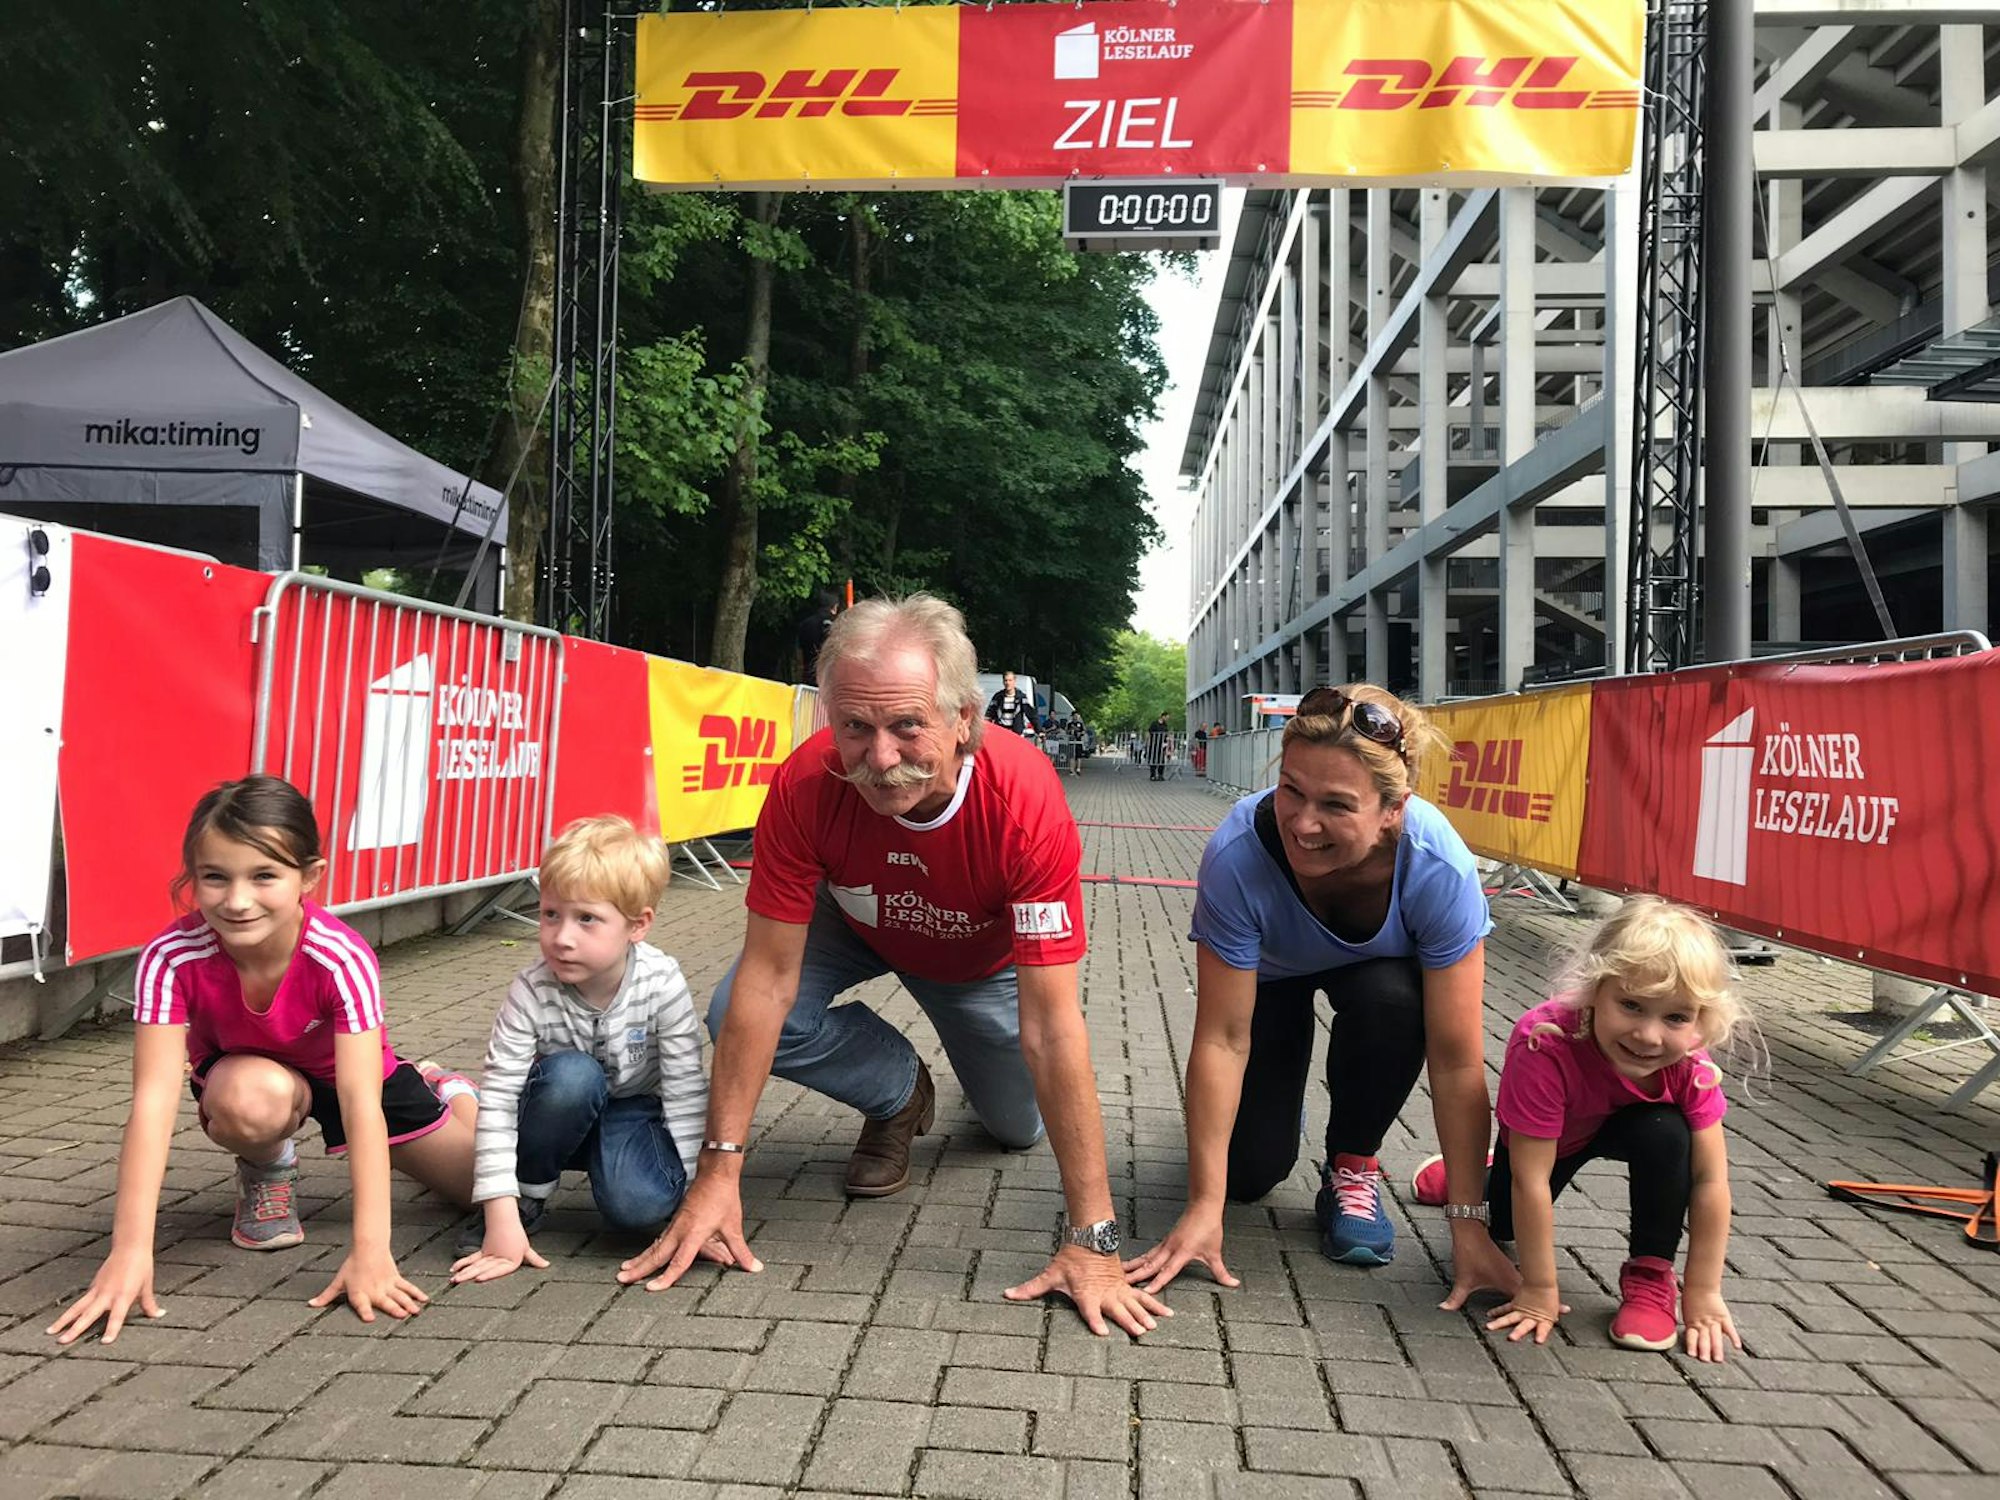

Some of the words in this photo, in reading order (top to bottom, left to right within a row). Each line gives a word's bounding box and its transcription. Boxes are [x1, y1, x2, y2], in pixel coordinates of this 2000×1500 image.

[1103, 26, 1176, 43] KÖLNER
[1103, 44, 1195, 60] LESELAUF
[678, 68, 914, 120] DHL
[1336, 56, 1592, 110] DHL
[1052, 96, 1194, 150] ZIEL
[85, 418, 261, 455] mika:timing
[437, 674, 525, 730] KÖLNER
[698, 714, 783, 791] DHL
[1759, 721, 1865, 780] KÖLNER
[1446, 738, 1531, 820] DHL
[1754, 788, 1899, 845] LESELAUF
[884, 890, 971, 925] KÖLNER
